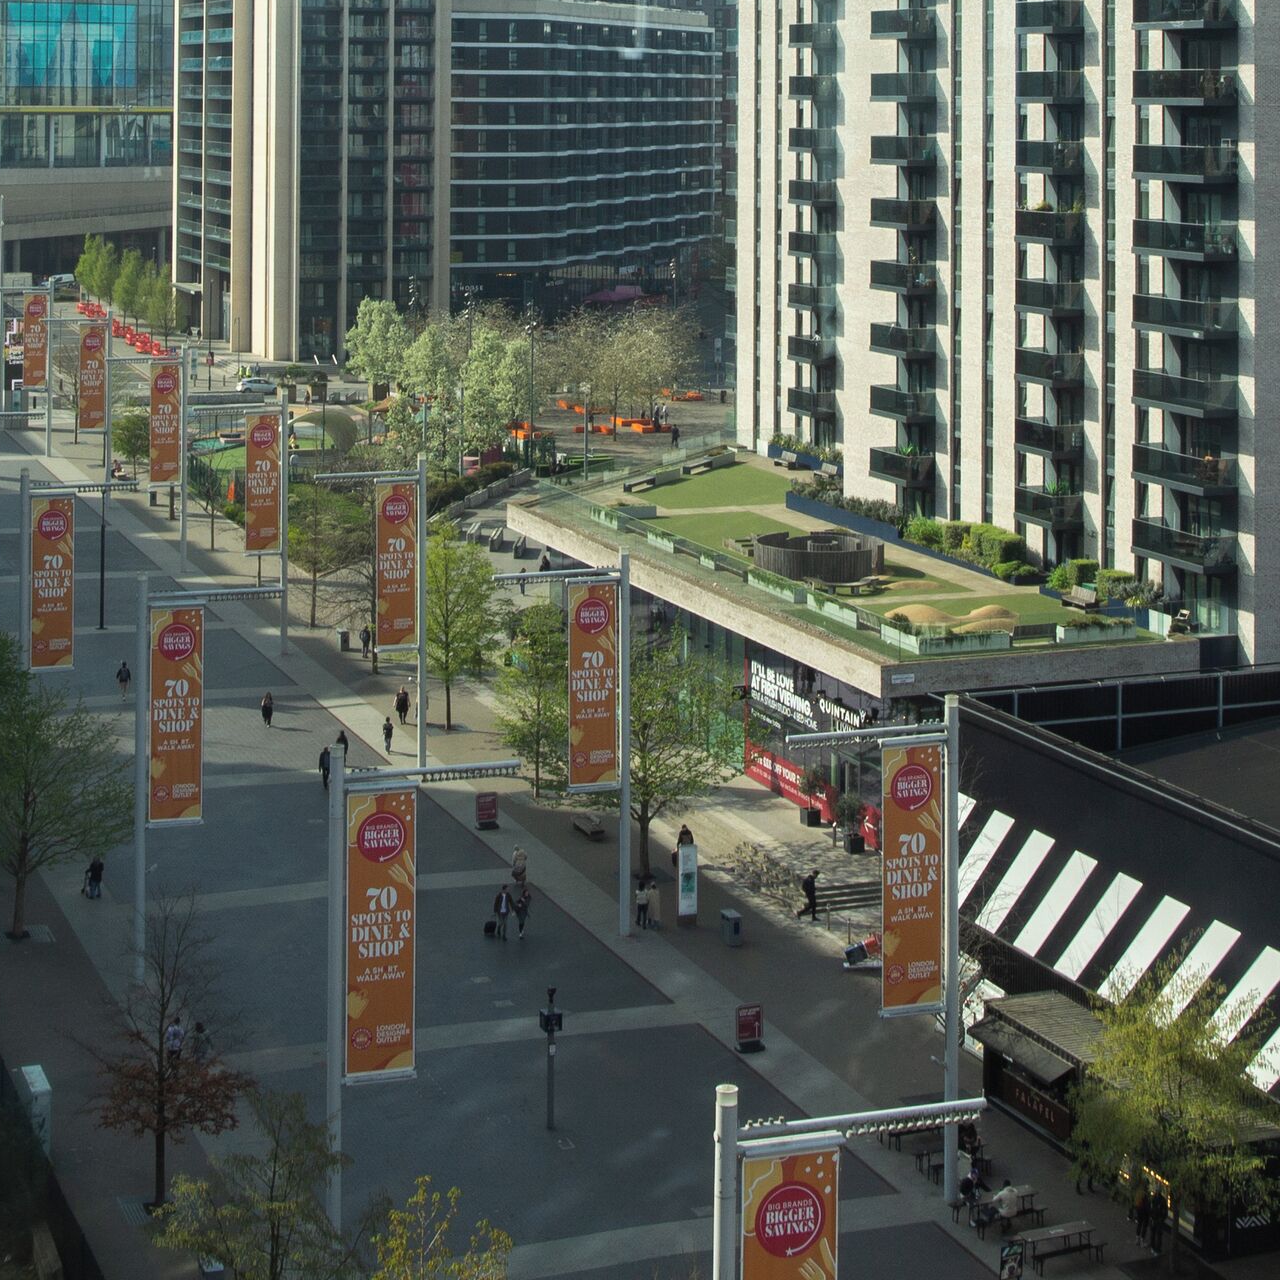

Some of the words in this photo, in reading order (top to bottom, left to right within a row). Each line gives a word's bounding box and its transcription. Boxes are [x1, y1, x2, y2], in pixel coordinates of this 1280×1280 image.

[387, 537, 406, 552] 70
[43, 554, 63, 570] 70
[379, 552, 402, 561] SPOTS
[403, 551, 413, 559] TO
[379, 560, 403, 570] DINE
[406, 559, 413, 569] &
[34, 570, 59, 578] SPOTS
[60, 569, 71, 577] TO
[383, 569, 410, 580] SHOP
[34, 578, 60, 588] DINE
[63, 577, 71, 587] &
[38, 587, 67, 599] SHOP
[580, 610, 605, 618] BIGGER
[163, 643, 191, 651] SAVINGS
[581, 651, 604, 669] 70
[571, 669, 600, 679] SPOTS
[601, 668, 614, 677] TO
[572, 678, 601, 691] DINE
[605, 677, 613, 689] &
[766, 667, 775, 684] BE
[776, 672, 794, 693] LOVE
[164, 679, 189, 698] 70
[751, 673, 761, 691] AT
[761, 678, 779, 701] FIRST
[577, 689, 609, 703] SHOP
[153, 698, 185, 709] SPOTS
[186, 697, 200, 707] TO
[153, 708, 186, 721] DINE
[190, 707, 199, 719] &
[819, 698, 860, 728] QUINTAIN
[159, 720, 194, 734] SHOP
[836, 720, 856, 733] LIVI
[896, 780, 928, 790] BIGGER
[896, 788, 928, 798] SAVINGS
[364, 829, 400, 840] BIGGER
[364, 838, 400, 849] SAVINGS
[898, 832, 926, 856] 70
[885, 856, 921, 871] SPOTS
[923, 854, 938, 866] TO
[886, 868, 923, 886] DINE
[927, 866, 938, 882] &
[892, 882, 932, 901] SHOP
[366, 886, 398, 911] 70
[904, 905, 928, 914] SHRT
[351, 911, 392, 927] SPOTS
[394, 909, 411, 922] TO
[890, 914, 912, 923] WALK
[913, 911, 934, 920] AWAY
[351, 924, 393, 943] DINE
[399, 922, 410, 939] &
[358, 940, 405, 960] SHOP
[372, 965, 399, 974] SHRT
[908, 959, 935, 968] LONDON
[908, 964, 938, 974] DESIGNER
[356, 974, 381, 983] WALK
[382, 971, 406, 980] AWAY
[908, 971, 930, 980] OUTLET
[376, 1023, 406, 1032] LONDON
[376, 1028, 411, 1038] DESIGNER
[376, 1035, 401, 1045] OUTLET
[1015, 1088, 1055, 1123] FALAFEL
[767, 1202, 782, 1212] BIG
[783, 1199, 814, 1209] BRANDS
[765, 1208, 815, 1225] BIGGER
[765, 1220, 816, 1238] SAVINGS
